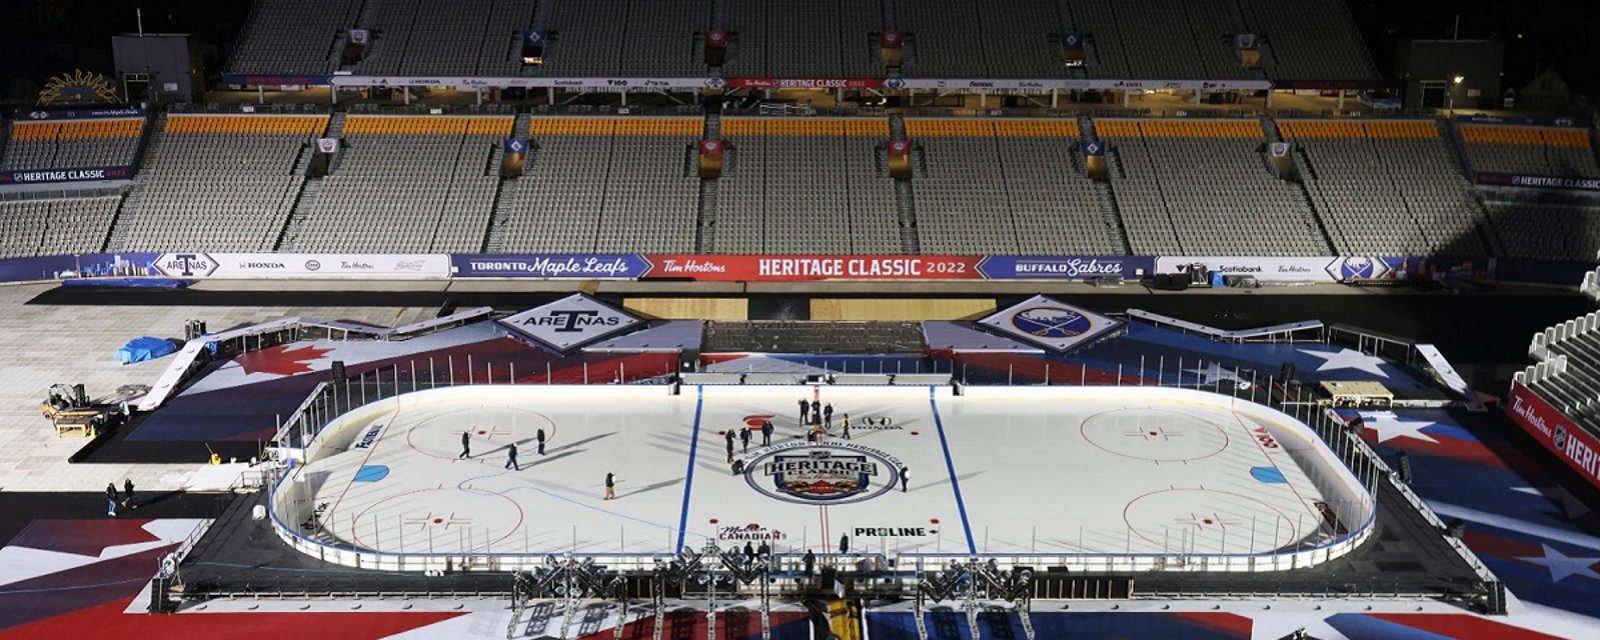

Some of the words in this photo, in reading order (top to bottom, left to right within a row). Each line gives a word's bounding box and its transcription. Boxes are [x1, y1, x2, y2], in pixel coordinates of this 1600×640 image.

[780, 79, 815, 87] HERITAGE
[816, 79, 847, 87] CLASSIC
[23, 171, 66, 182] HERITAGE
[68, 170, 105, 180] CLASSIC
[1520, 176, 1562, 187] HERITAGE
[470, 262, 527, 271] TORONTO
[527, 257, 582, 276] Maple
[582, 257, 629, 276] Leafs
[662, 259, 683, 272] Tim
[683, 259, 726, 273] Hortons
[759, 259, 843, 276] HERITAGE
[848, 259, 921, 276] CLASSIC
[926, 262, 966, 273] 2022
[1015, 263, 1067, 273] BUFFALO
[1067, 258, 1123, 277] Sabres
[1219, 264, 1263, 273] Scotiabank
[1512, 395, 1525, 417] Tim
[1524, 404, 1552, 438] Hortons
[1565, 434, 1600, 481] HERI
[771, 460, 873, 474] HERITAGE
